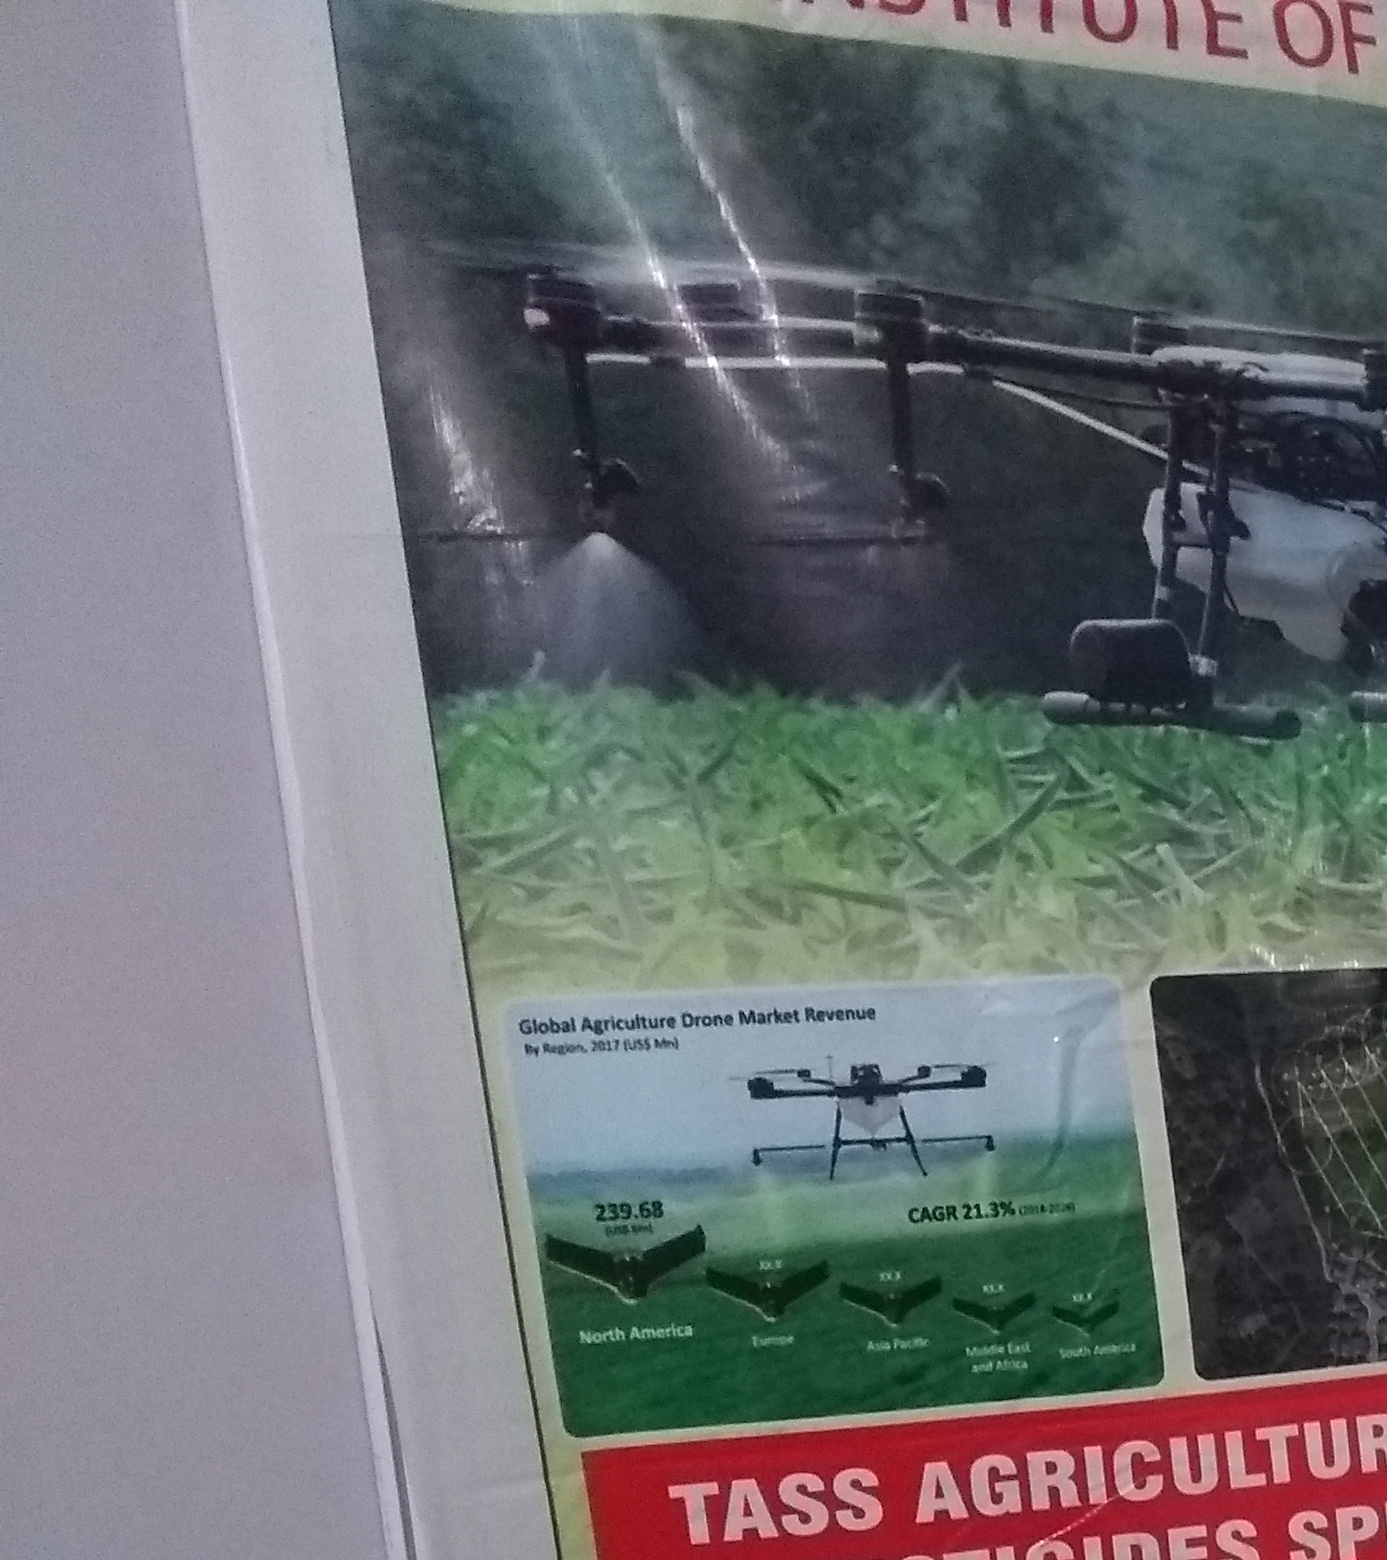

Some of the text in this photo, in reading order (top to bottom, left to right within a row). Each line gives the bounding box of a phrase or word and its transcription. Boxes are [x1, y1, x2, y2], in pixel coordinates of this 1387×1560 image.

[1271, 0, 1377, 75] OF
[519, 1005, 877, 1037] Global Agriculture Drone Market Revenue
[524, 1041, 541, 1057] By
[591, 1038, 621, 1053] 2017
[594, 1199, 665, 1223] 239.68
[907, 1204, 959, 1225] CAGR
[961, 1200, 1017, 1221] 21.3%
[578, 1323, 694, 1346] North America
[752, 1334, 795, 1349] Europe
[866, 1336, 931, 1351] Asia Pacific
[1006, 1341, 1032, 1355] East
[668, 1467, 884, 1545] TASS
